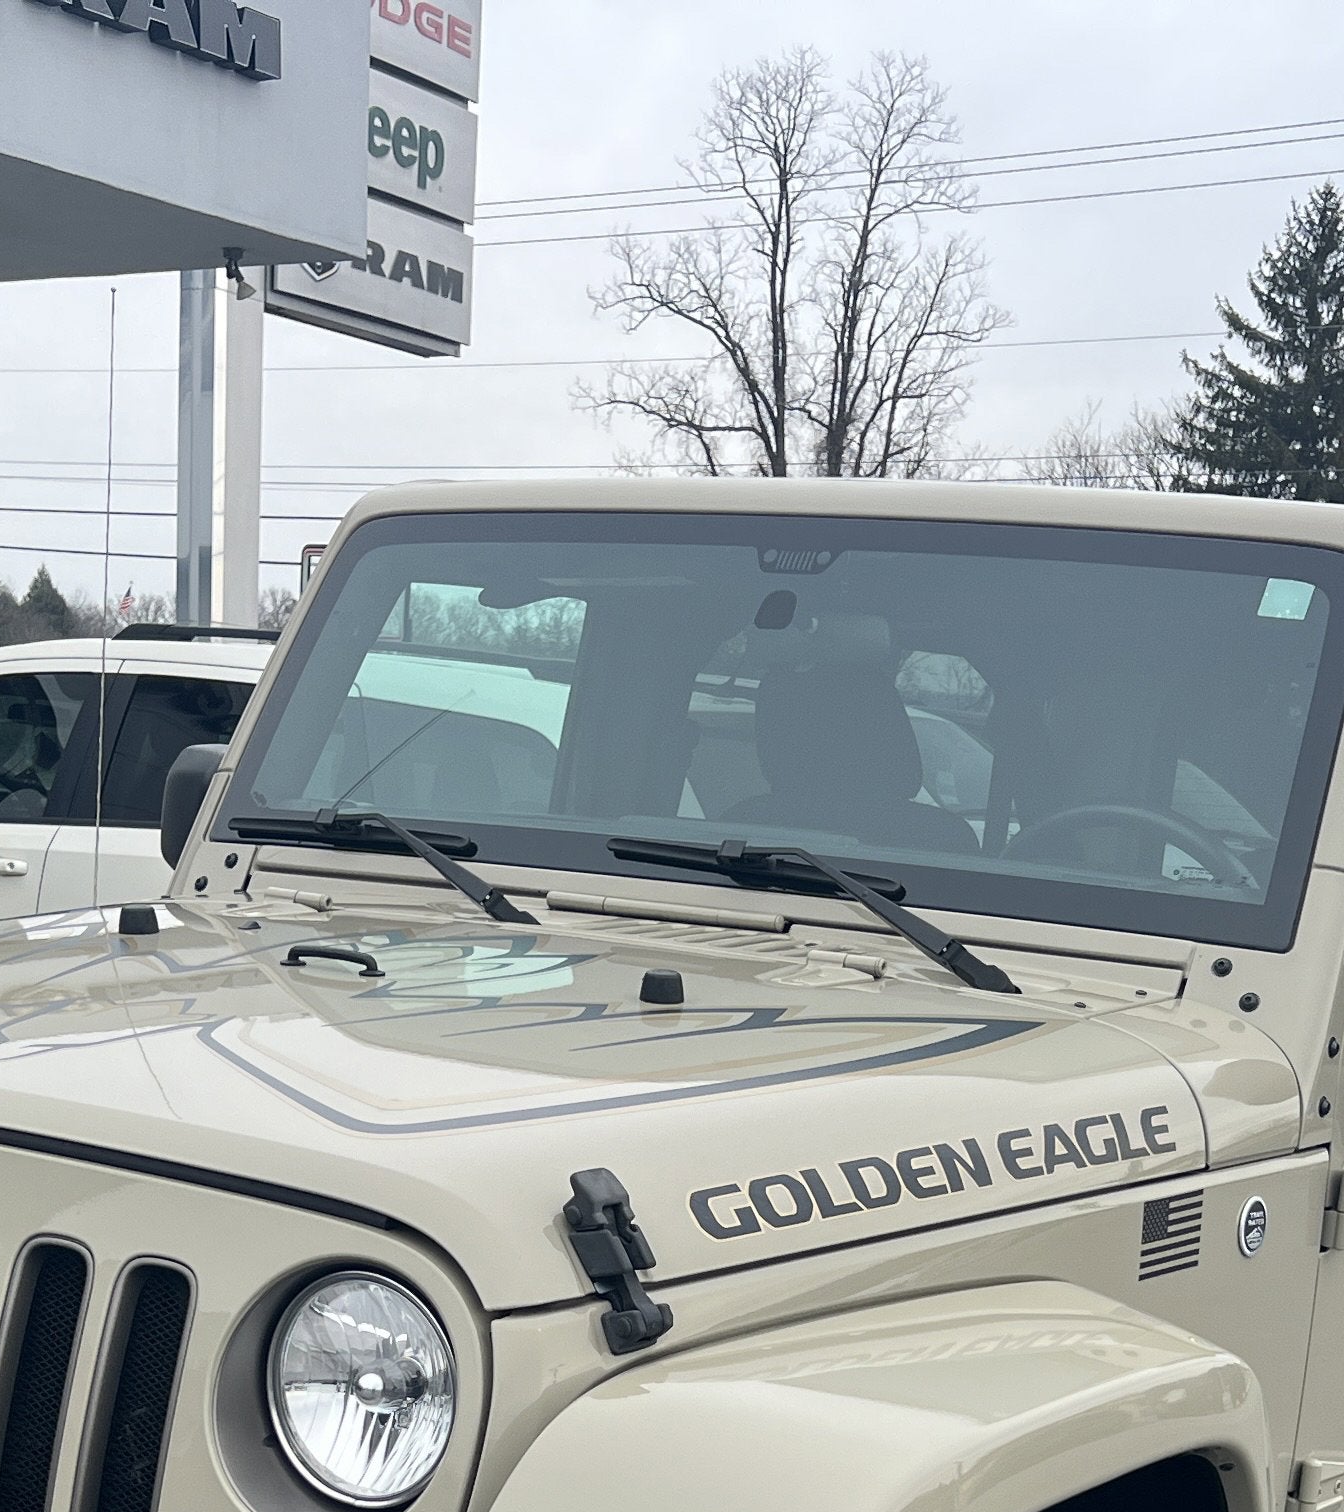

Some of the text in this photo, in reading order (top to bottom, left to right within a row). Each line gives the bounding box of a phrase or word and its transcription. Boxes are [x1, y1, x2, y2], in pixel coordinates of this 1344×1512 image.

[31, 0, 281, 81] AM
[370, 0, 472, 58] DGE
[351, 240, 464, 304] RAM
[689, 1105, 1177, 1243] GOLDEN EAGLE
